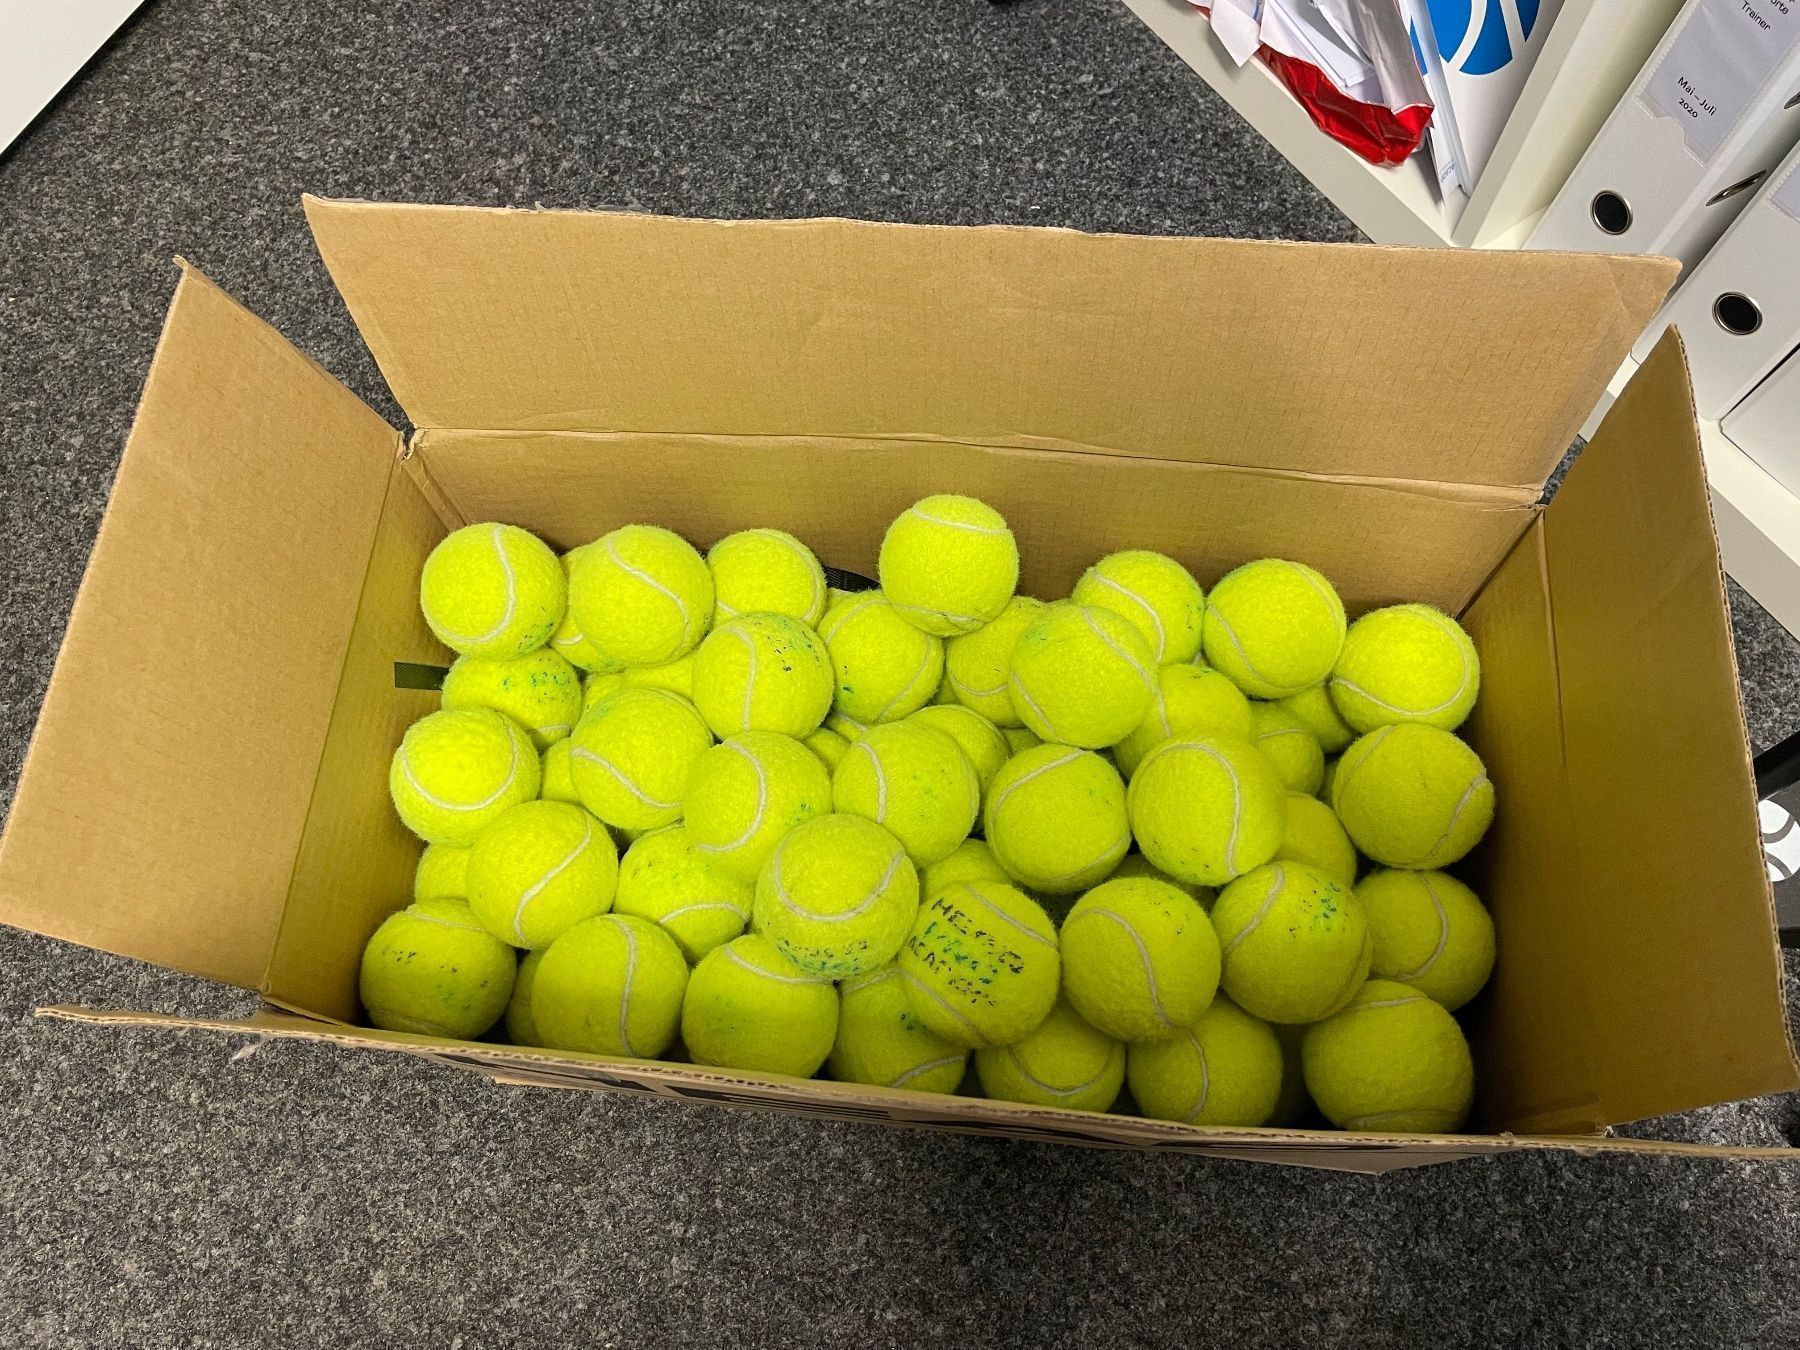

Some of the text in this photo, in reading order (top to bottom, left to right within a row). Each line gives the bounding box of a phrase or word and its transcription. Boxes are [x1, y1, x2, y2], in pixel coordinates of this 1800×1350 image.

[1742, 0, 1771, 30] Trainer
[1677, 76, 1696, 96] Mai
[1699, 99, 1717, 117] Juli
[1678, 97, 1698, 118] 2020
